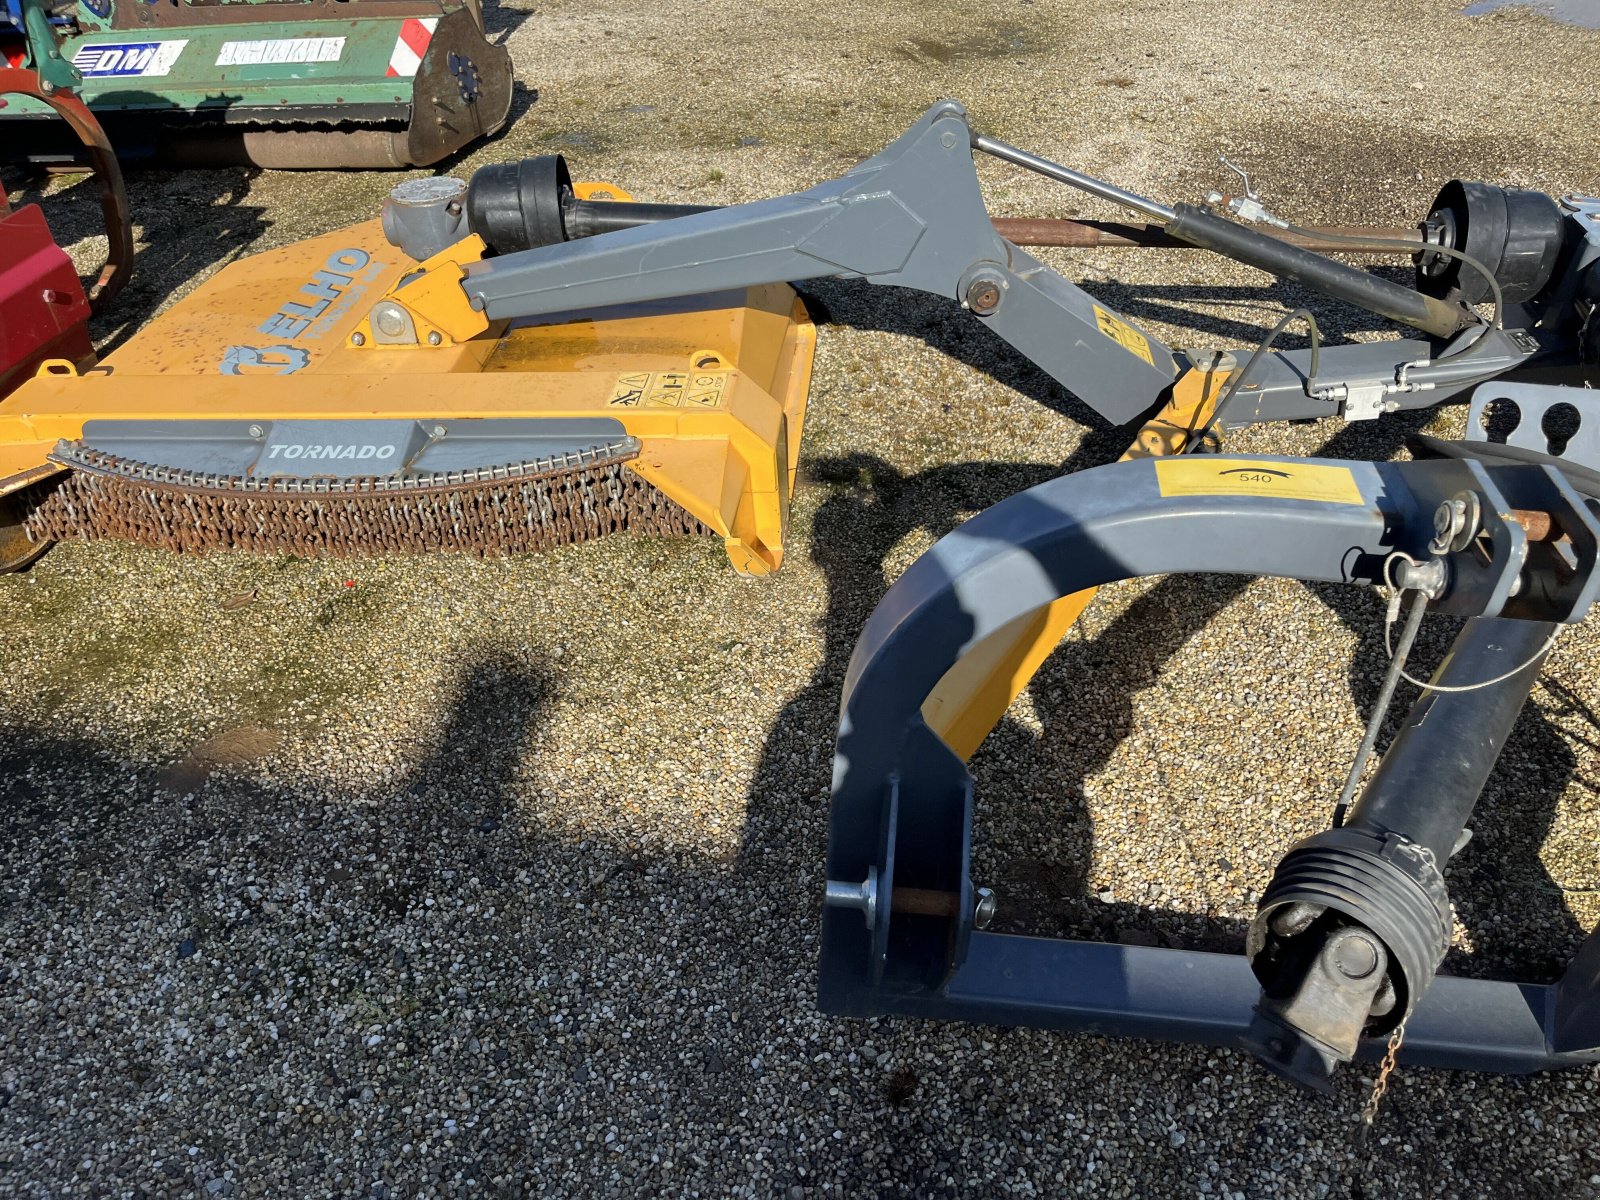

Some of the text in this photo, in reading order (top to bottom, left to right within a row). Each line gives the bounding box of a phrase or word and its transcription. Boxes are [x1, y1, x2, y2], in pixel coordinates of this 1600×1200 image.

[257, 248, 371, 340] ELHO
[268, 444, 396, 459] TORNADO
[1239, 473, 1272, 483] 540
